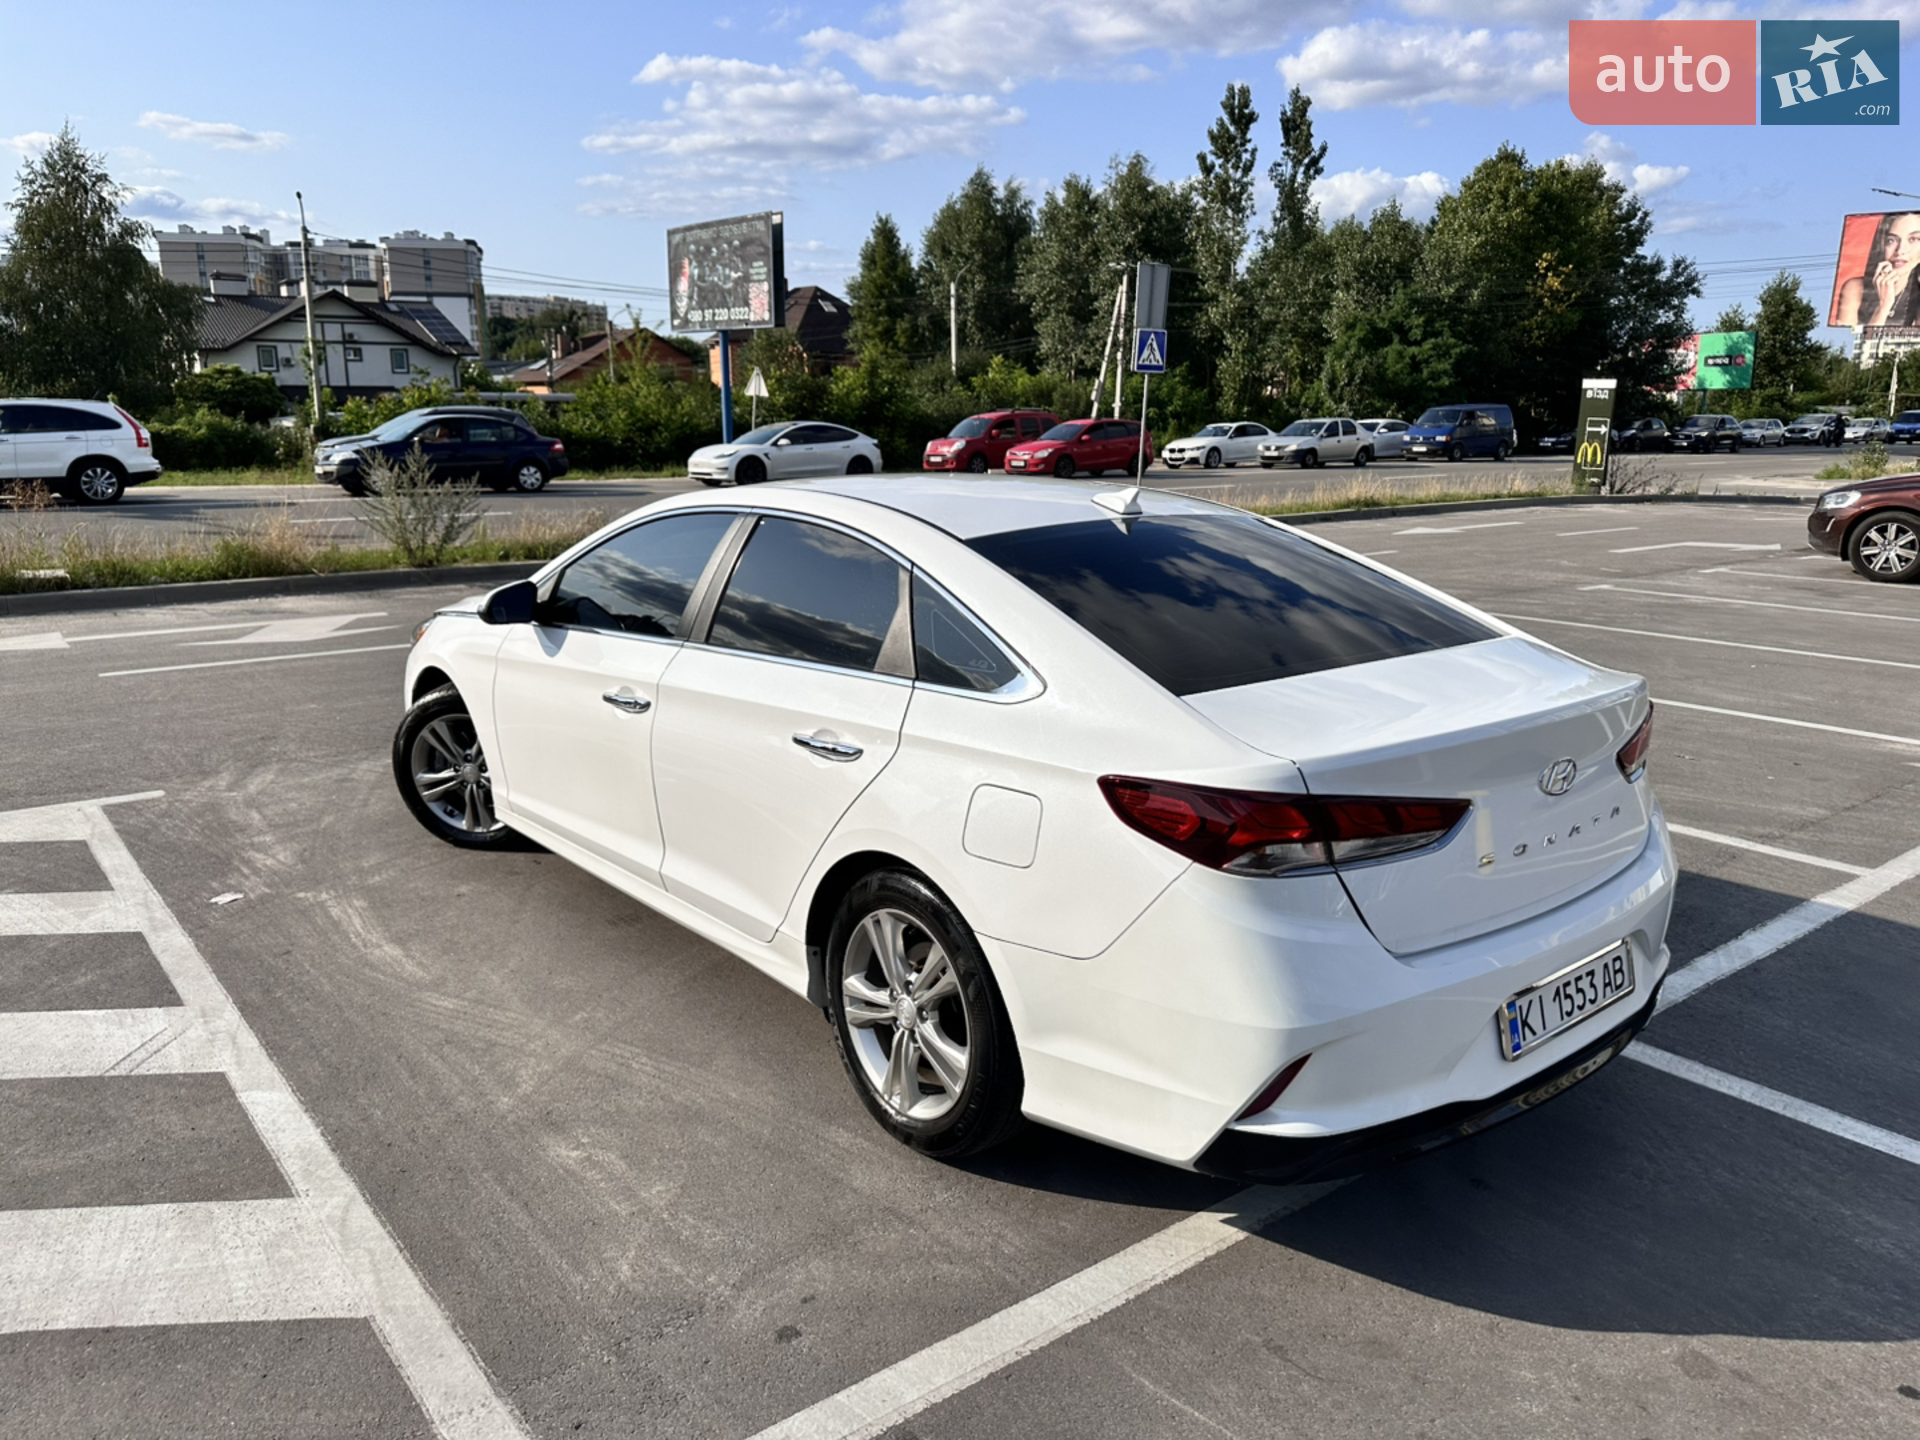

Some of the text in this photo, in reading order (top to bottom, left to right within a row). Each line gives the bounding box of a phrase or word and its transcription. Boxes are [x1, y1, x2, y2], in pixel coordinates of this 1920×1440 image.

[1478, 805, 1620, 868] SONATA
[1552, 969, 1598, 1022] 1553
[1602, 955, 1626, 999] AB
